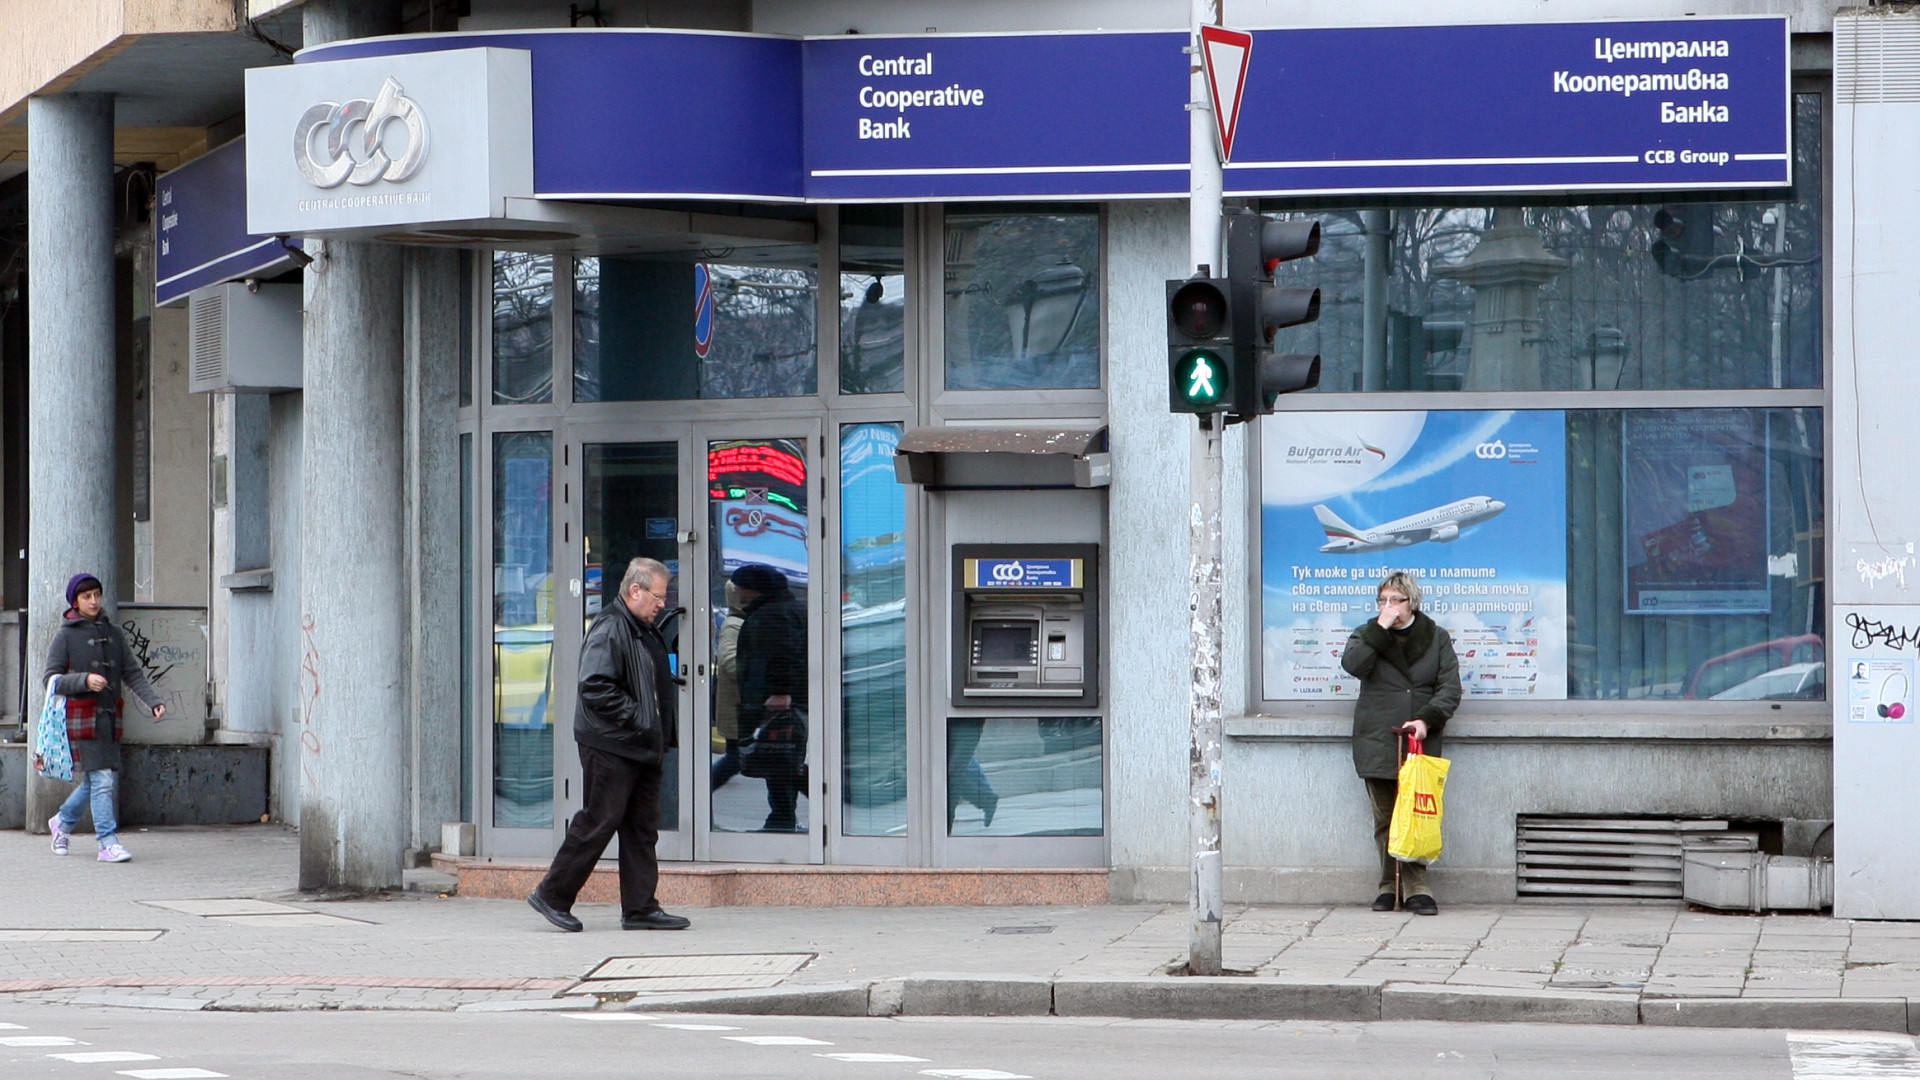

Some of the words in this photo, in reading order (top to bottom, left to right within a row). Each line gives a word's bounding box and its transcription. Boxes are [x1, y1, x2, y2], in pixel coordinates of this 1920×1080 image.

[1595, 37, 1729, 64] Централна
[859, 52, 932, 76] Central
[1554, 68, 1729, 97] Кооперативна
[859, 84, 984, 113] Cooperative
[1661, 100, 1729, 123] Банка
[859, 117, 911, 139] Bank
[1644, 150, 1676, 164] CCB
[1680, 150, 1729, 166] Group
[299, 199, 339, 212] CENTRAL
[342, 193, 403, 208] COOPERATIVE
[406, 191, 431, 204] BANK
[1287, 446, 1342, 460] Bulgaria
[1344, 446, 1363, 456] Air
[1292, 565, 1312, 580] Тук
[1315, 566, 1347, 578] може
[1351, 568, 1365, 580] да
[1430, 568, 1437, 577] и
[1440, 568, 1496, 578] платите
[1292, 583, 1320, 595] своя
[1436, 585, 1450, 596] до
[1454, 583, 1488, 595] всяка
[1492, 583, 1529, 595] точка
[1292, 602, 1306, 612] на
[1309, 600, 1348, 612] света
[1364, 602, 1371, 612] с
[1434, 601, 1448, 614] Ер
[1452, 602, 1458, 612] и
[1462, 600, 1532, 614] партньори!
